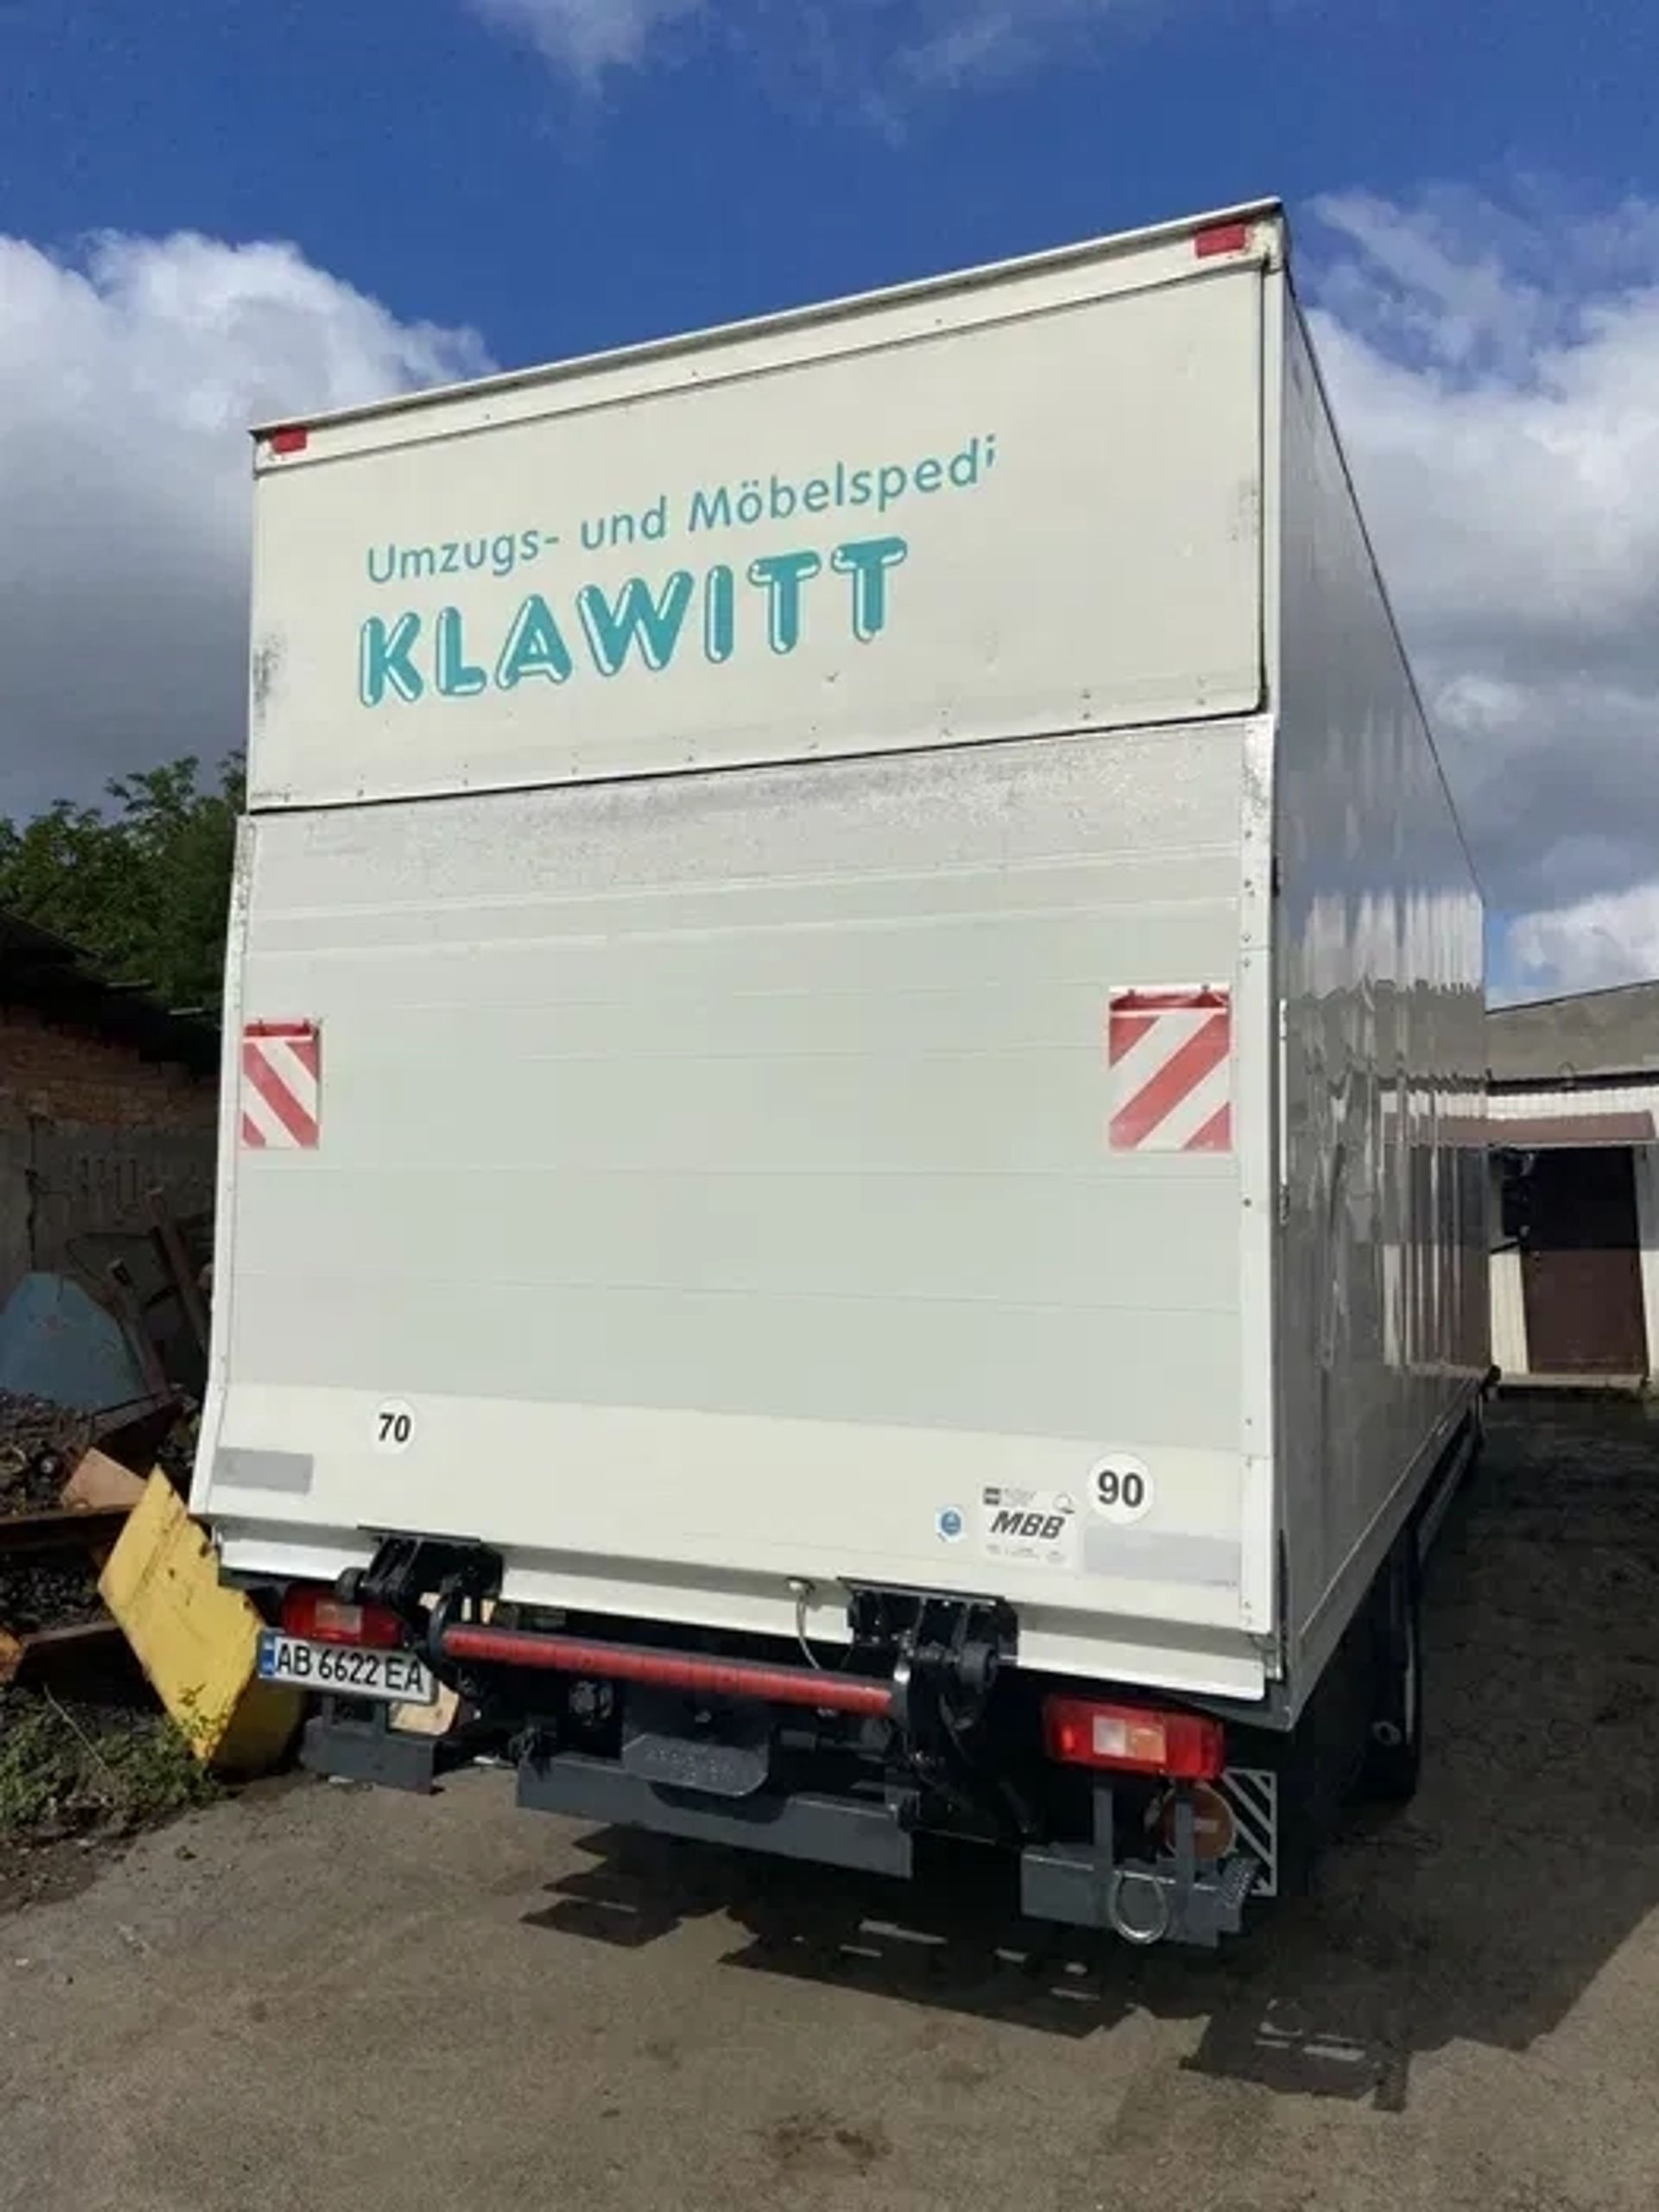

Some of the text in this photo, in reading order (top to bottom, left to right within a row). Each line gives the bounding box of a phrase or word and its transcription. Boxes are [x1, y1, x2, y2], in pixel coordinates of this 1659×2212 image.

[367, 531, 559, 583] Umzugs-
[581, 496, 667, 550] und
[358, 537, 908, 707] KLAWITT
[378, 1412, 411, 1442] 70
[1097, 1470, 1144, 1508] 90
[989, 1510, 1065, 1539] MBB
[277, 1643, 423, 1693] AB 6622 EA
